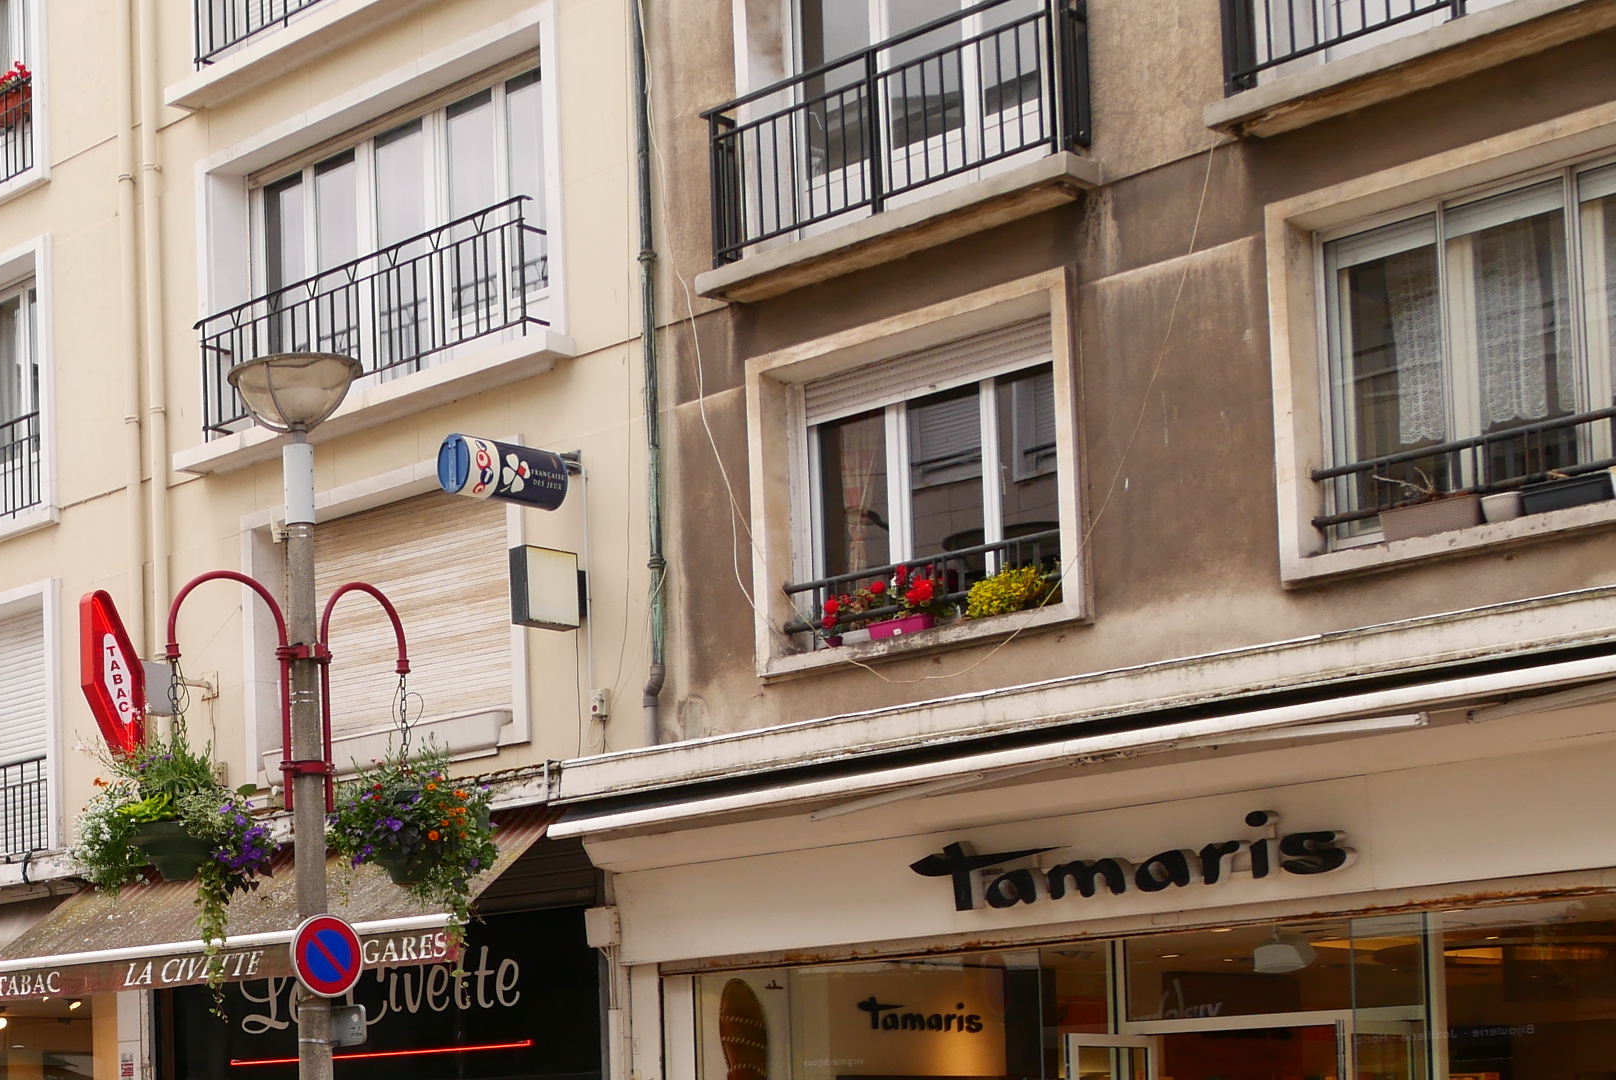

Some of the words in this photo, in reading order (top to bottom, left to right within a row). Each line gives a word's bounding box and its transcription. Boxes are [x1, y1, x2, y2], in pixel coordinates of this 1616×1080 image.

[531, 468, 565, 481] FRANÇAISE
[533, 478, 545, 487] DES
[546, 480, 562, 490] JEUX
[106, 645, 130, 713] TABAC
[909, 809, 1358, 911] Tamaris
[363, 932, 448, 964] GARES
[123, 961, 153, 987] LA
[161, 950, 264, 983] CIVETTE
[857, 996, 984, 1033] Tamaris
